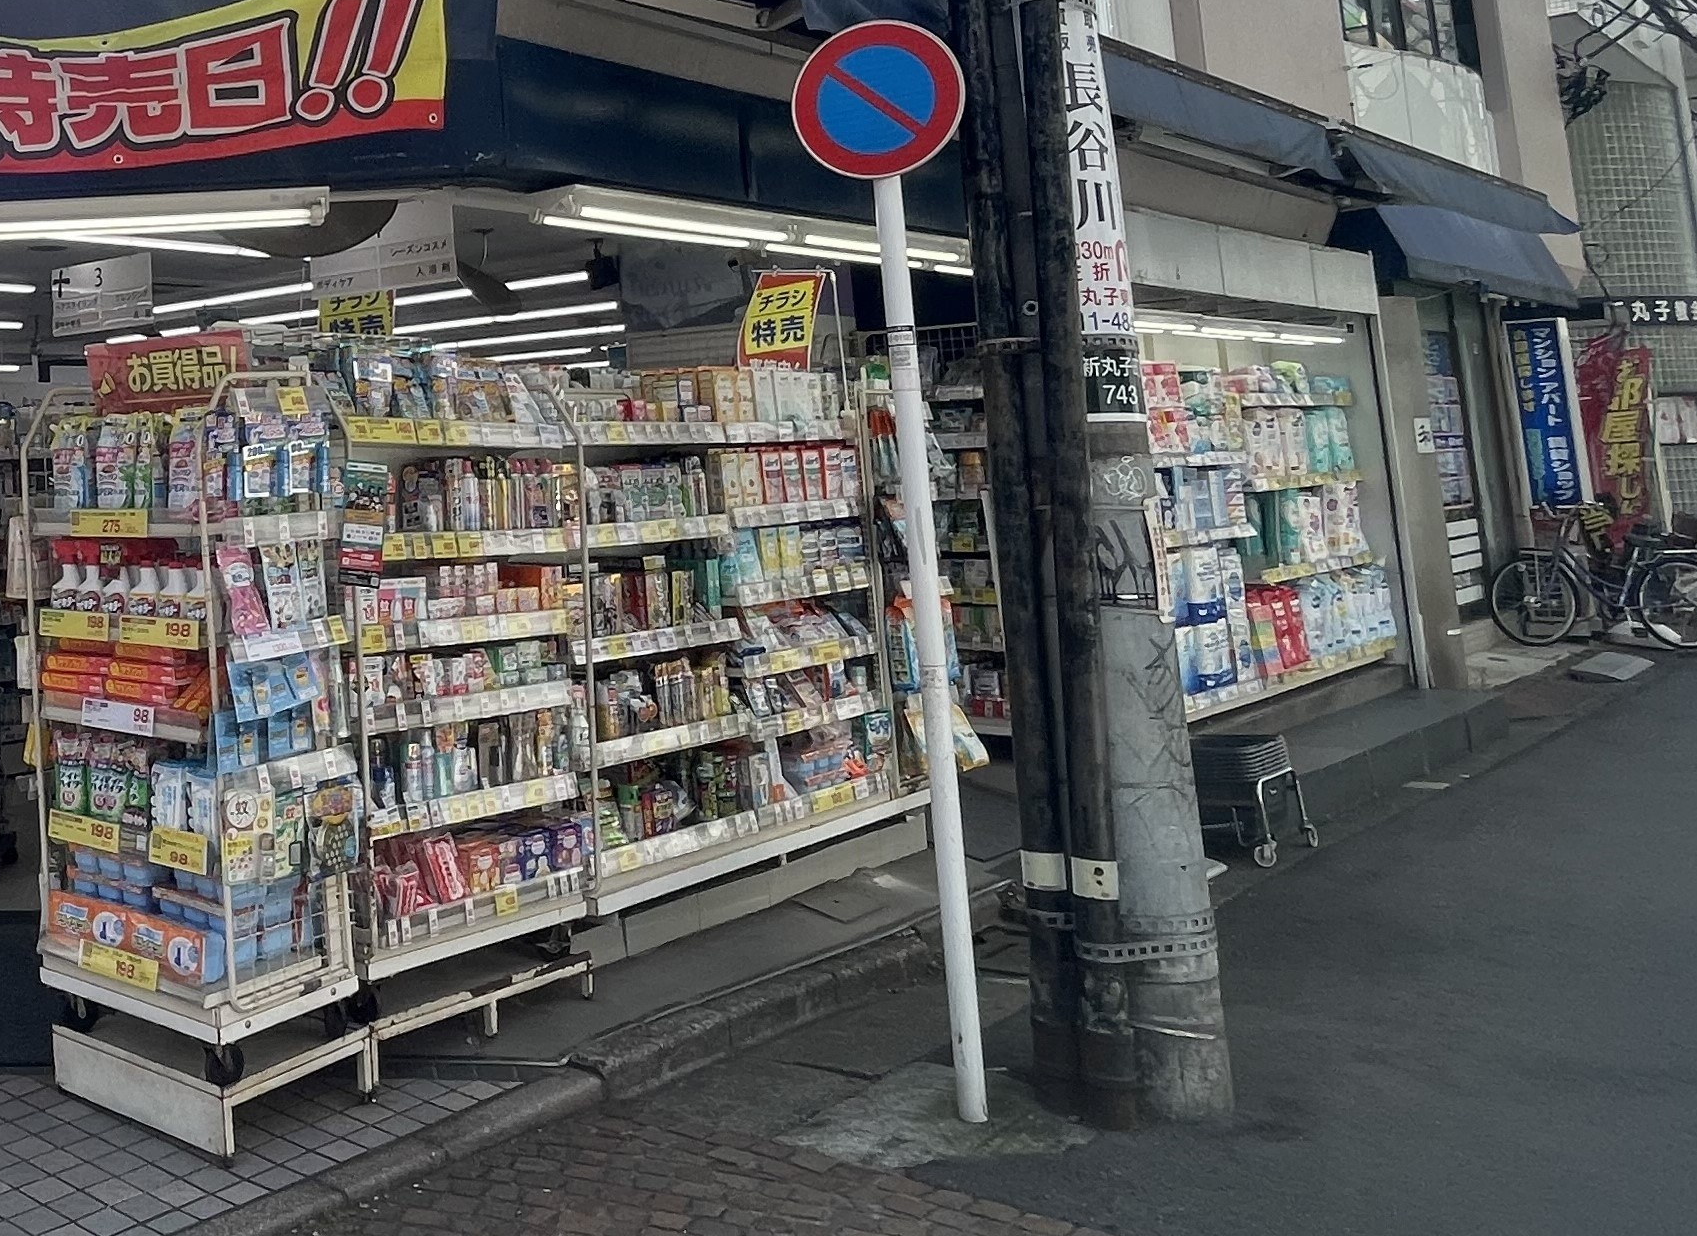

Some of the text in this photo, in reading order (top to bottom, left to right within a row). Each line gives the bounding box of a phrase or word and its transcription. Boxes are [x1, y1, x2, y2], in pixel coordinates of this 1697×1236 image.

[1064, 61, 1117, 232] 長谷川
[94, 267, 103, 287] 3
[758, 289, 807, 313] チラシ
[750, 315, 805, 348] 特売
[1102, 384, 1139, 405] 743
[102, 519, 121, 533] 275
[87, 616, 104, 629] 198
[165, 622, 192, 638] 198
[133, 708, 150, 723] 98
[90, 822, 114, 840] 198
